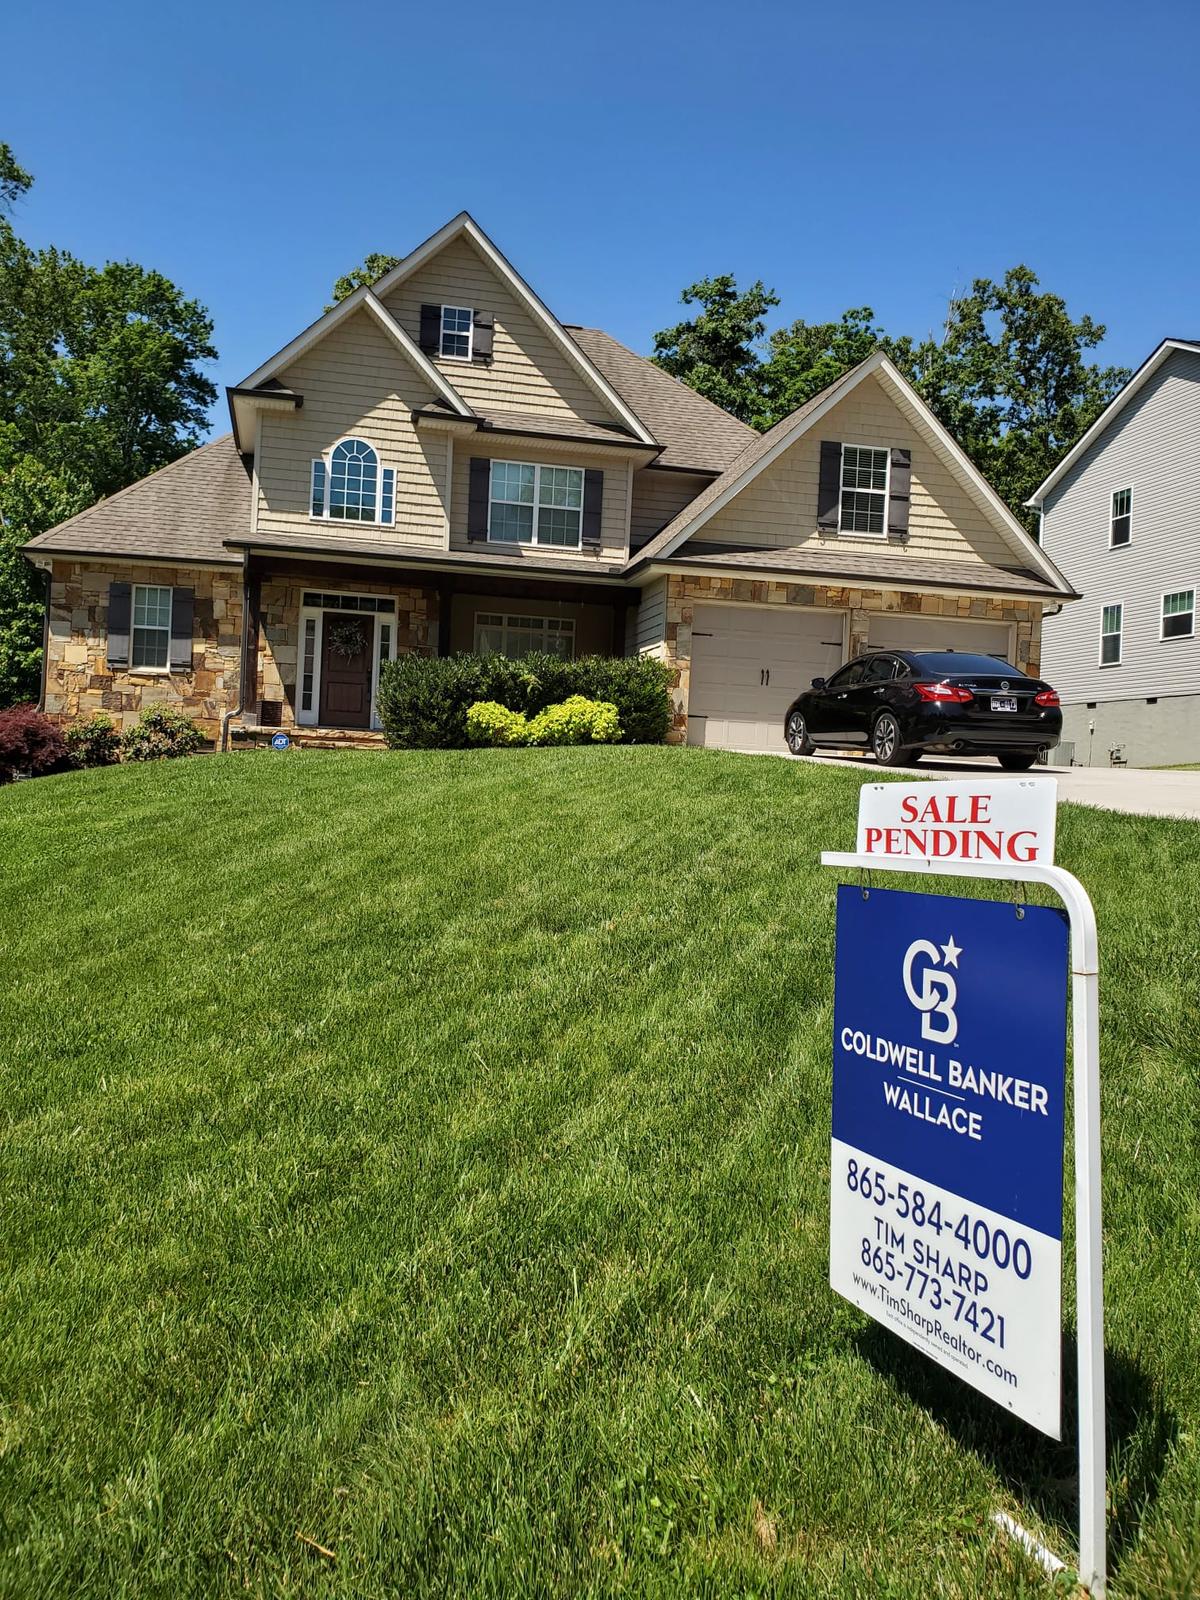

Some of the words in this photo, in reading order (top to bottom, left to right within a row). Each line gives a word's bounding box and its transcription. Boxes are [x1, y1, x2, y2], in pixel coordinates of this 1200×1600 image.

[865, 828, 1039, 863] PENDING
[900, 795, 992, 824] SALE
[841, 1027, 942, 1082] COLDWELL
[948, 1059, 1049, 1116] BANKER
[883, 1081, 982, 1141] WALLACE
[847, 1158, 1032, 1280] 865-584-4000
[874, 1216, 905, 1254] TIM
[913, 1238, 988, 1296] SHARP
[852, 1272, 1018, 1388] www.TimSharpRealtor.com
[861, 1237, 1005, 1349] 865-773-7421
